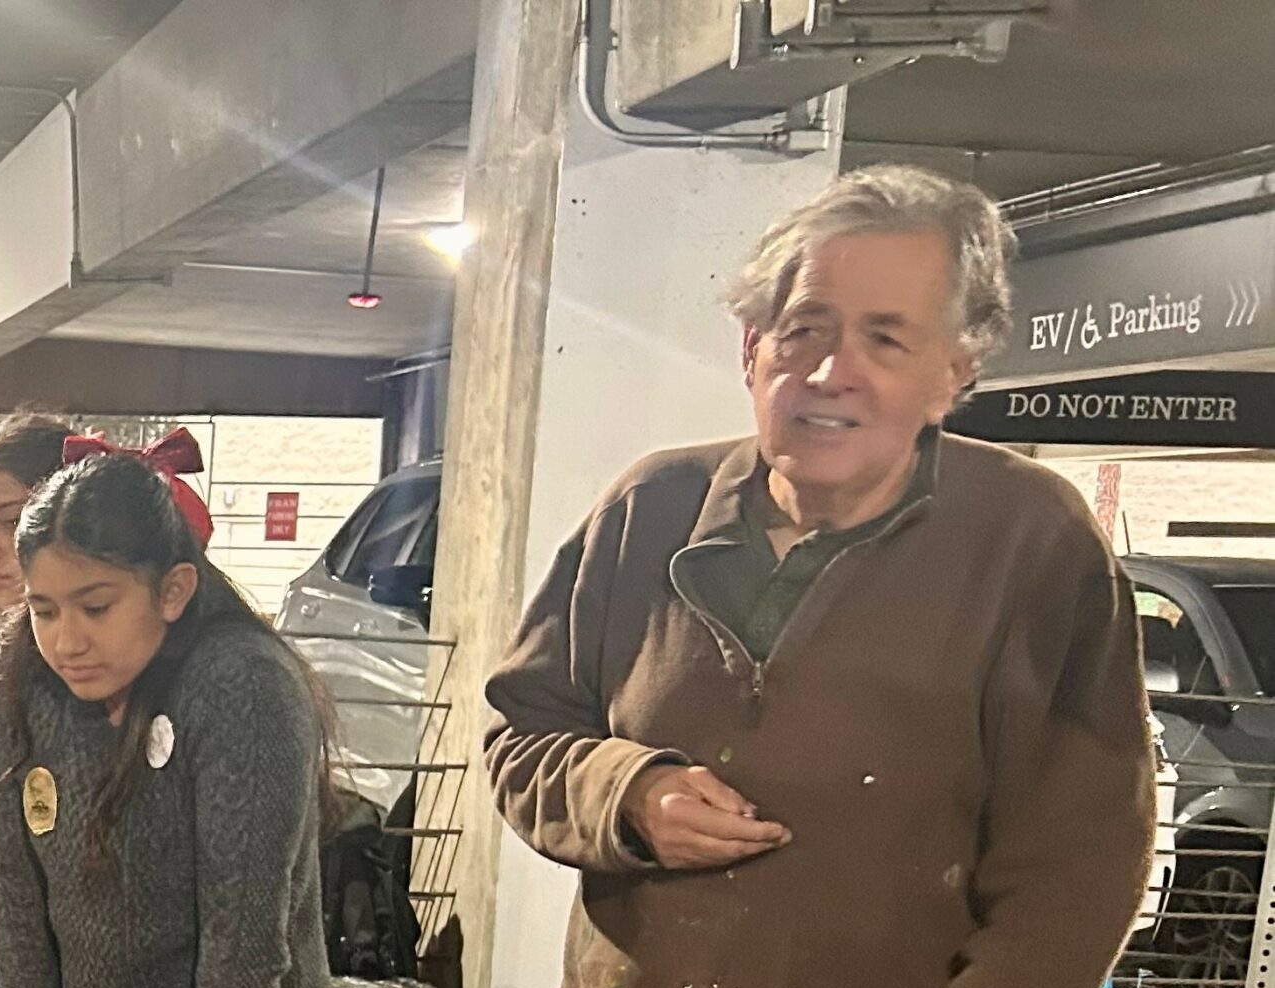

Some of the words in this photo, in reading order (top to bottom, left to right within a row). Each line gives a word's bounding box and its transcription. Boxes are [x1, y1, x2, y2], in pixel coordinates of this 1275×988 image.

[1108, 292, 1203, 339] Parking
[1007, 393, 1051, 418] DO
[1057, 394, 1125, 419] NOT
[1128, 396, 1237, 421] ENTER
